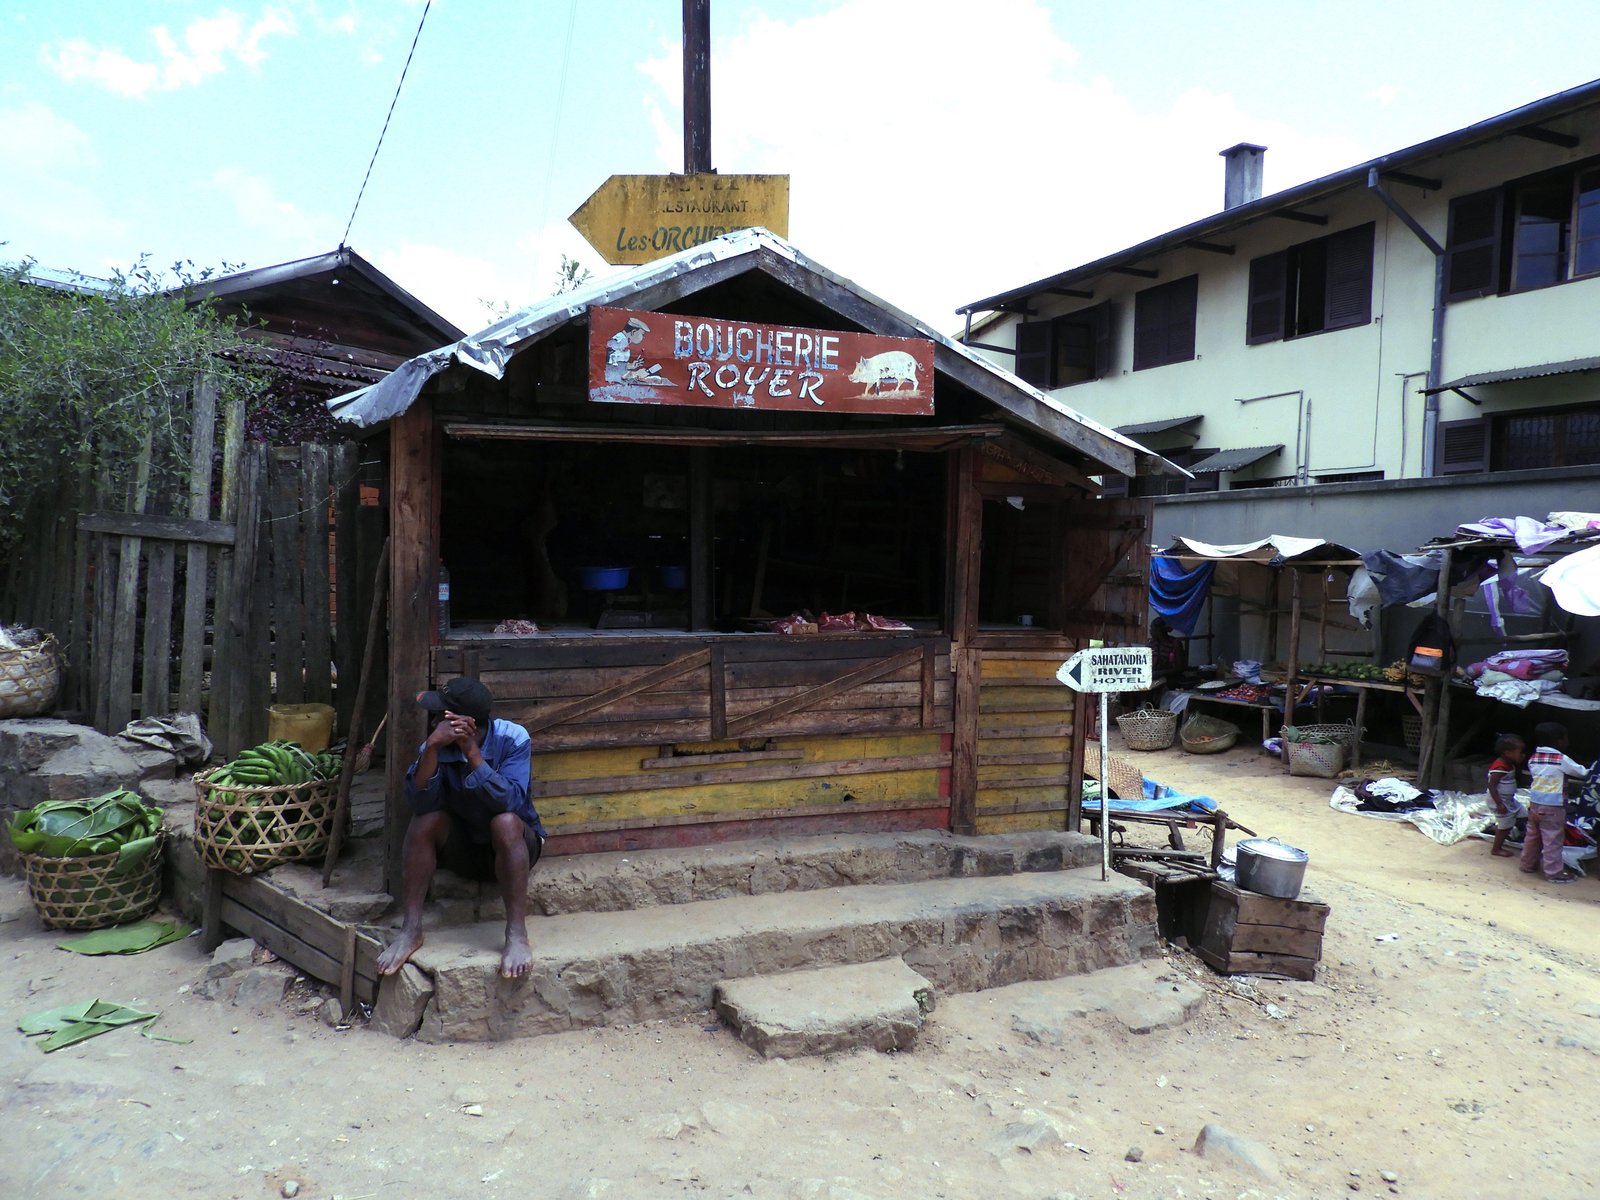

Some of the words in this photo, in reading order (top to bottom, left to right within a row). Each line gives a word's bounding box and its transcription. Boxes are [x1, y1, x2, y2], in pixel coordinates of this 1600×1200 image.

[659, 200, 749, 213] ESTAURANT
[616, 226, 648, 252] Les
[674, 321, 840, 371] BOUCHERIE
[687, 361, 825, 406] ROYER
[1091, 654, 1147, 667] SAHATANDRA
[1098, 667, 1142, 676] RIVER
